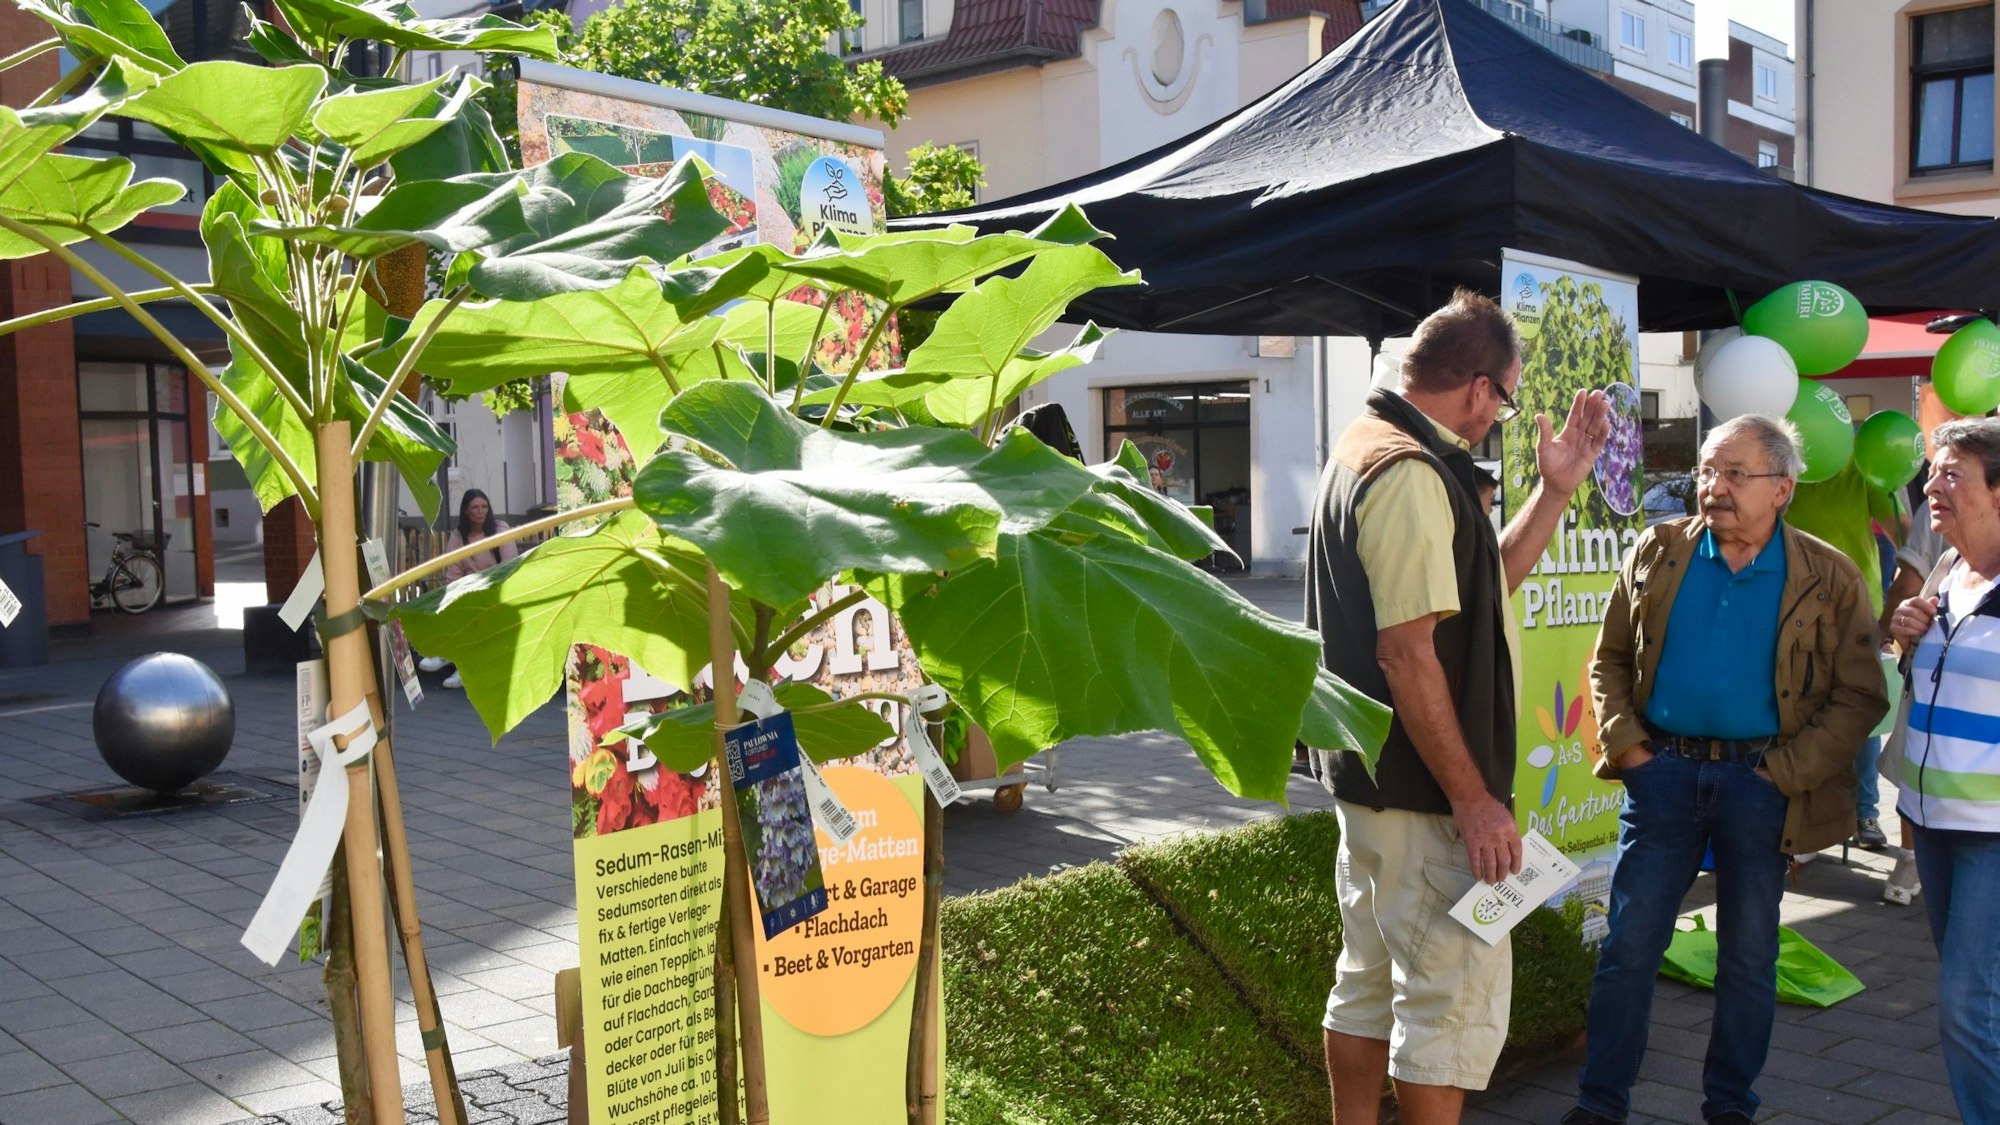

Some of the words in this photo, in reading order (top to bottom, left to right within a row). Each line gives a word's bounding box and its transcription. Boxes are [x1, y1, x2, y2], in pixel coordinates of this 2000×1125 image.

[819, 203, 858, 225] Klima
[1516, 301, 1537, 313] Klima
[1799, 284, 1811, 318] TAHIRI
[1264, 378, 1271, 394] 1
[1131, 410, 1151, 418] ALLE
[1152, 409, 1167, 418] ART
[743, 730, 779, 750] PAULOWNIA
[1558, 741, 1582, 766] A+S
[1527, 809, 1553, 837] Das
[596, 868, 678, 900] Verschiedene
[680, 860, 708, 880] bunte
[842, 879, 857, 900] &
[859, 876, 917, 899] Garage
[597, 891, 678, 922] Sedumsorten
[680, 882, 708, 900] direkt
[708, 876, 722, 892] als
[598, 927, 614, 944] fix
[616, 923, 627, 940] &
[628, 915, 667, 935] fertige
[668, 903, 711, 926] Verlege-
[803, 907, 889, 939] Flachdach
[600, 943, 647, 967] Matten.
[649, 928, 691, 953] Einfach
[773, 953, 814, 977] Beet
[816, 948, 829, 970] &
[831, 939, 914, 968] Vorgarten
[600, 970, 623, 989] wie
[625, 962, 658, 982] einen
[660, 945, 706, 972] Teppich.
[602, 993, 620, 1011] für
[623, 987, 642, 1004] die
[603, 1012, 625, 1032] auf
[627, 994, 691, 1026] Flachdach,
[604, 1035, 634, 1054] oder
[635, 1017, 684, 1043] Carport,
[686, 1010, 702, 1028] als
[605, 1049, 648, 1076] decker
[650, 1042, 676, 1061] oder
[679, 1034, 696, 1052] für
[697, 1028, 716, 1045] Bee
[607, 1077, 638, 1098] Blüte
[640, 1069, 662, 1085] von
[664, 1056, 685, 1078] Juli
[687, 1052, 704, 1070] bis
[608, 1084, 679, 1119] Wuchshöhe
[681, 1078, 699, 1093] ca.
[701, 1070, 711, 1085] 10
